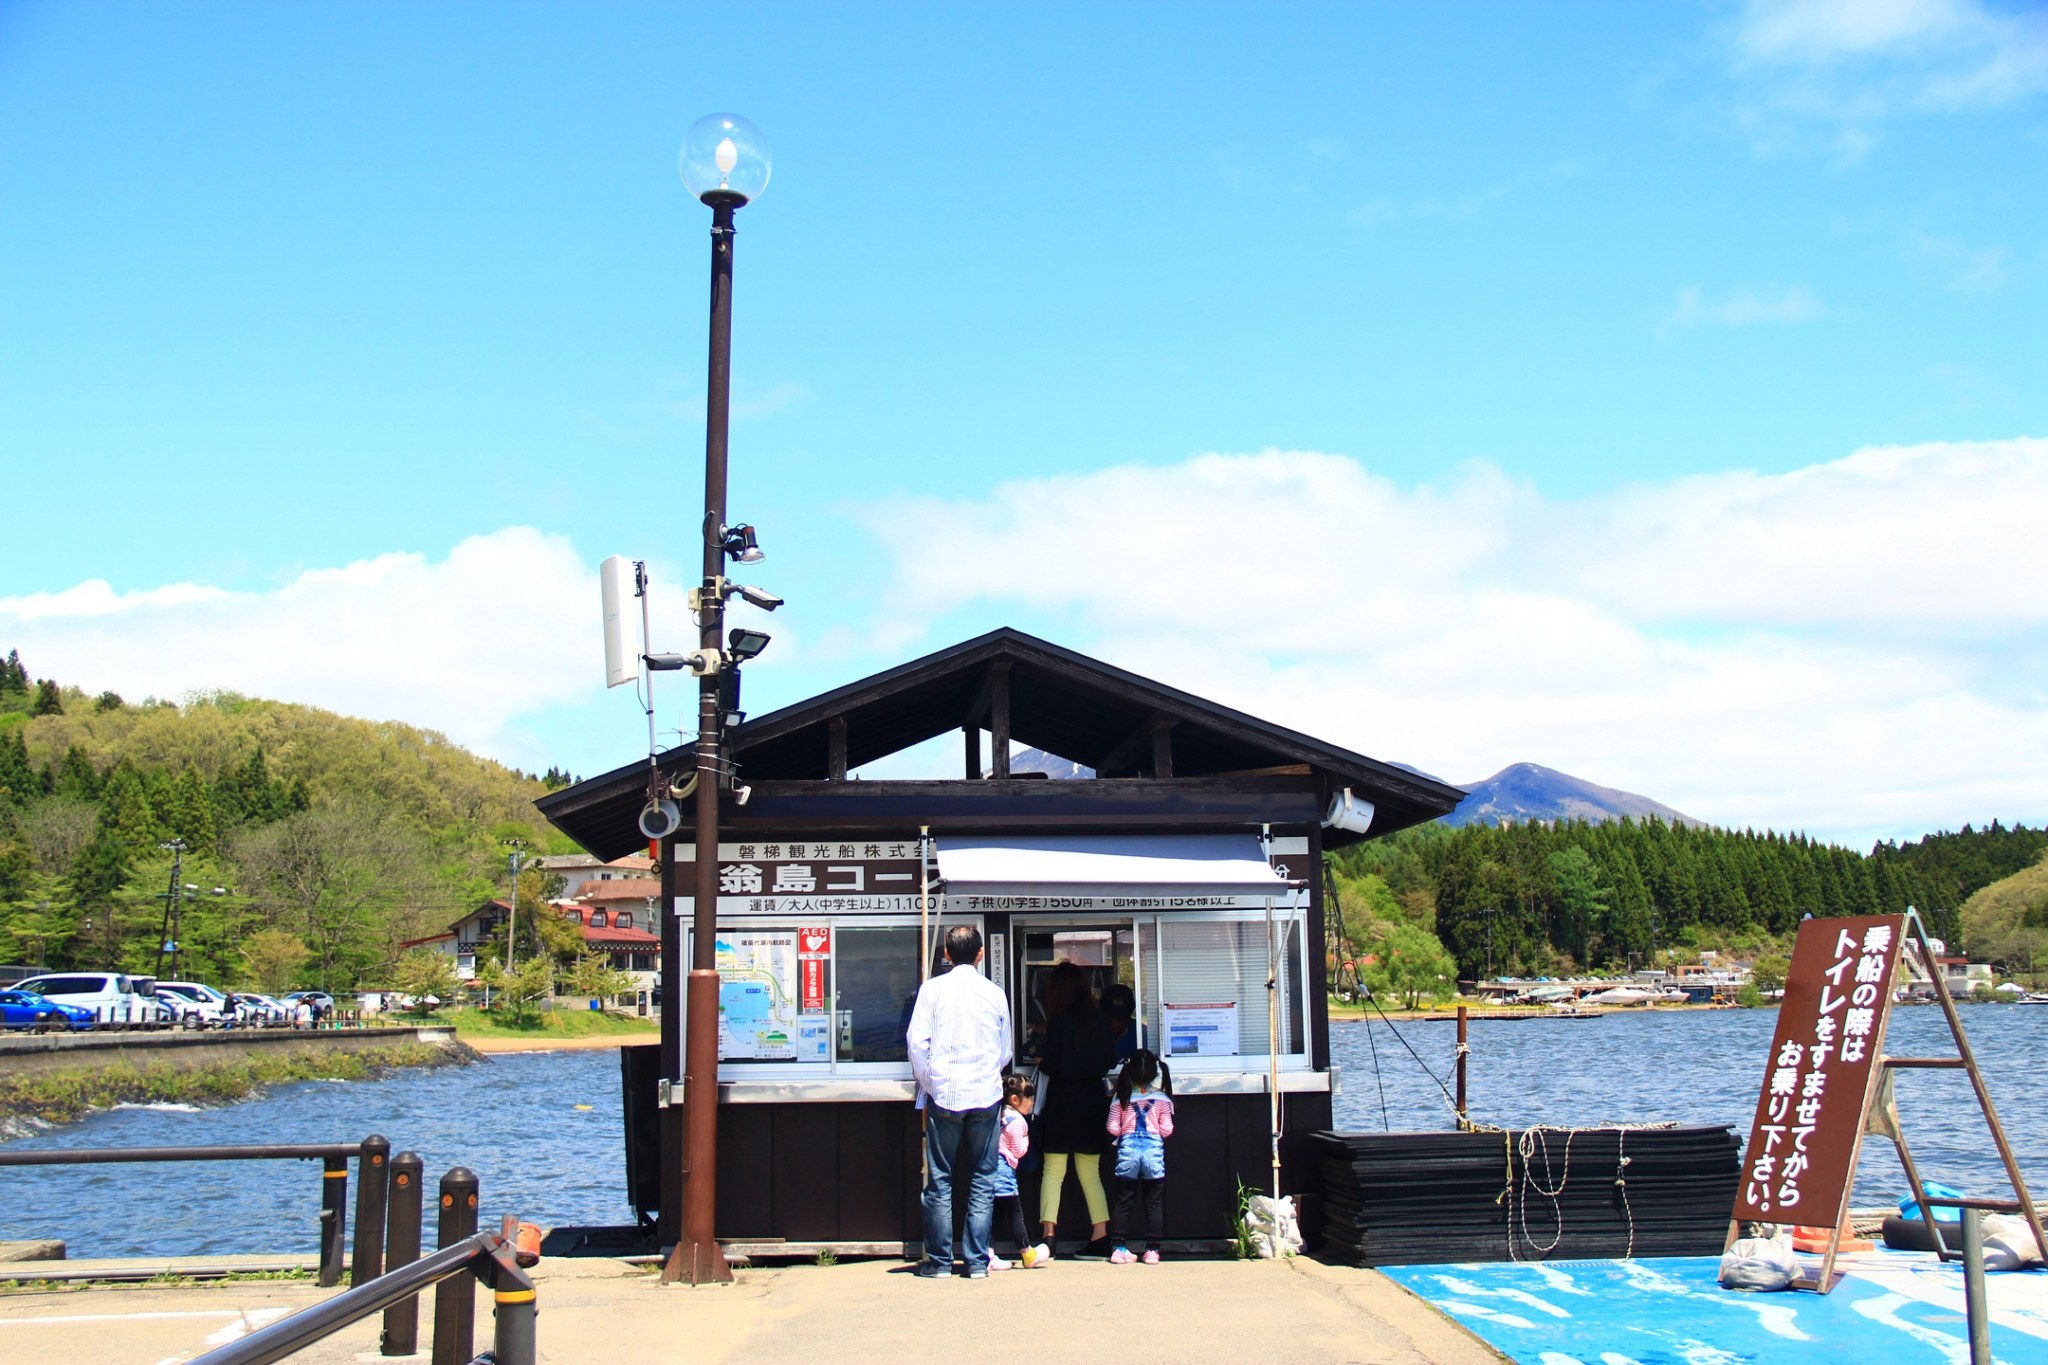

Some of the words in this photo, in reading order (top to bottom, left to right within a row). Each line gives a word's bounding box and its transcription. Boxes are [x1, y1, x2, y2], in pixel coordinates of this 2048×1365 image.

[801, 928, 828, 936] AED
[1840, 925, 1892, 1062] 乗船の際は
[1746, 1040, 1804, 1212] お乗り下さい。
[1778, 928, 1857, 1207] トイレをすませてから
